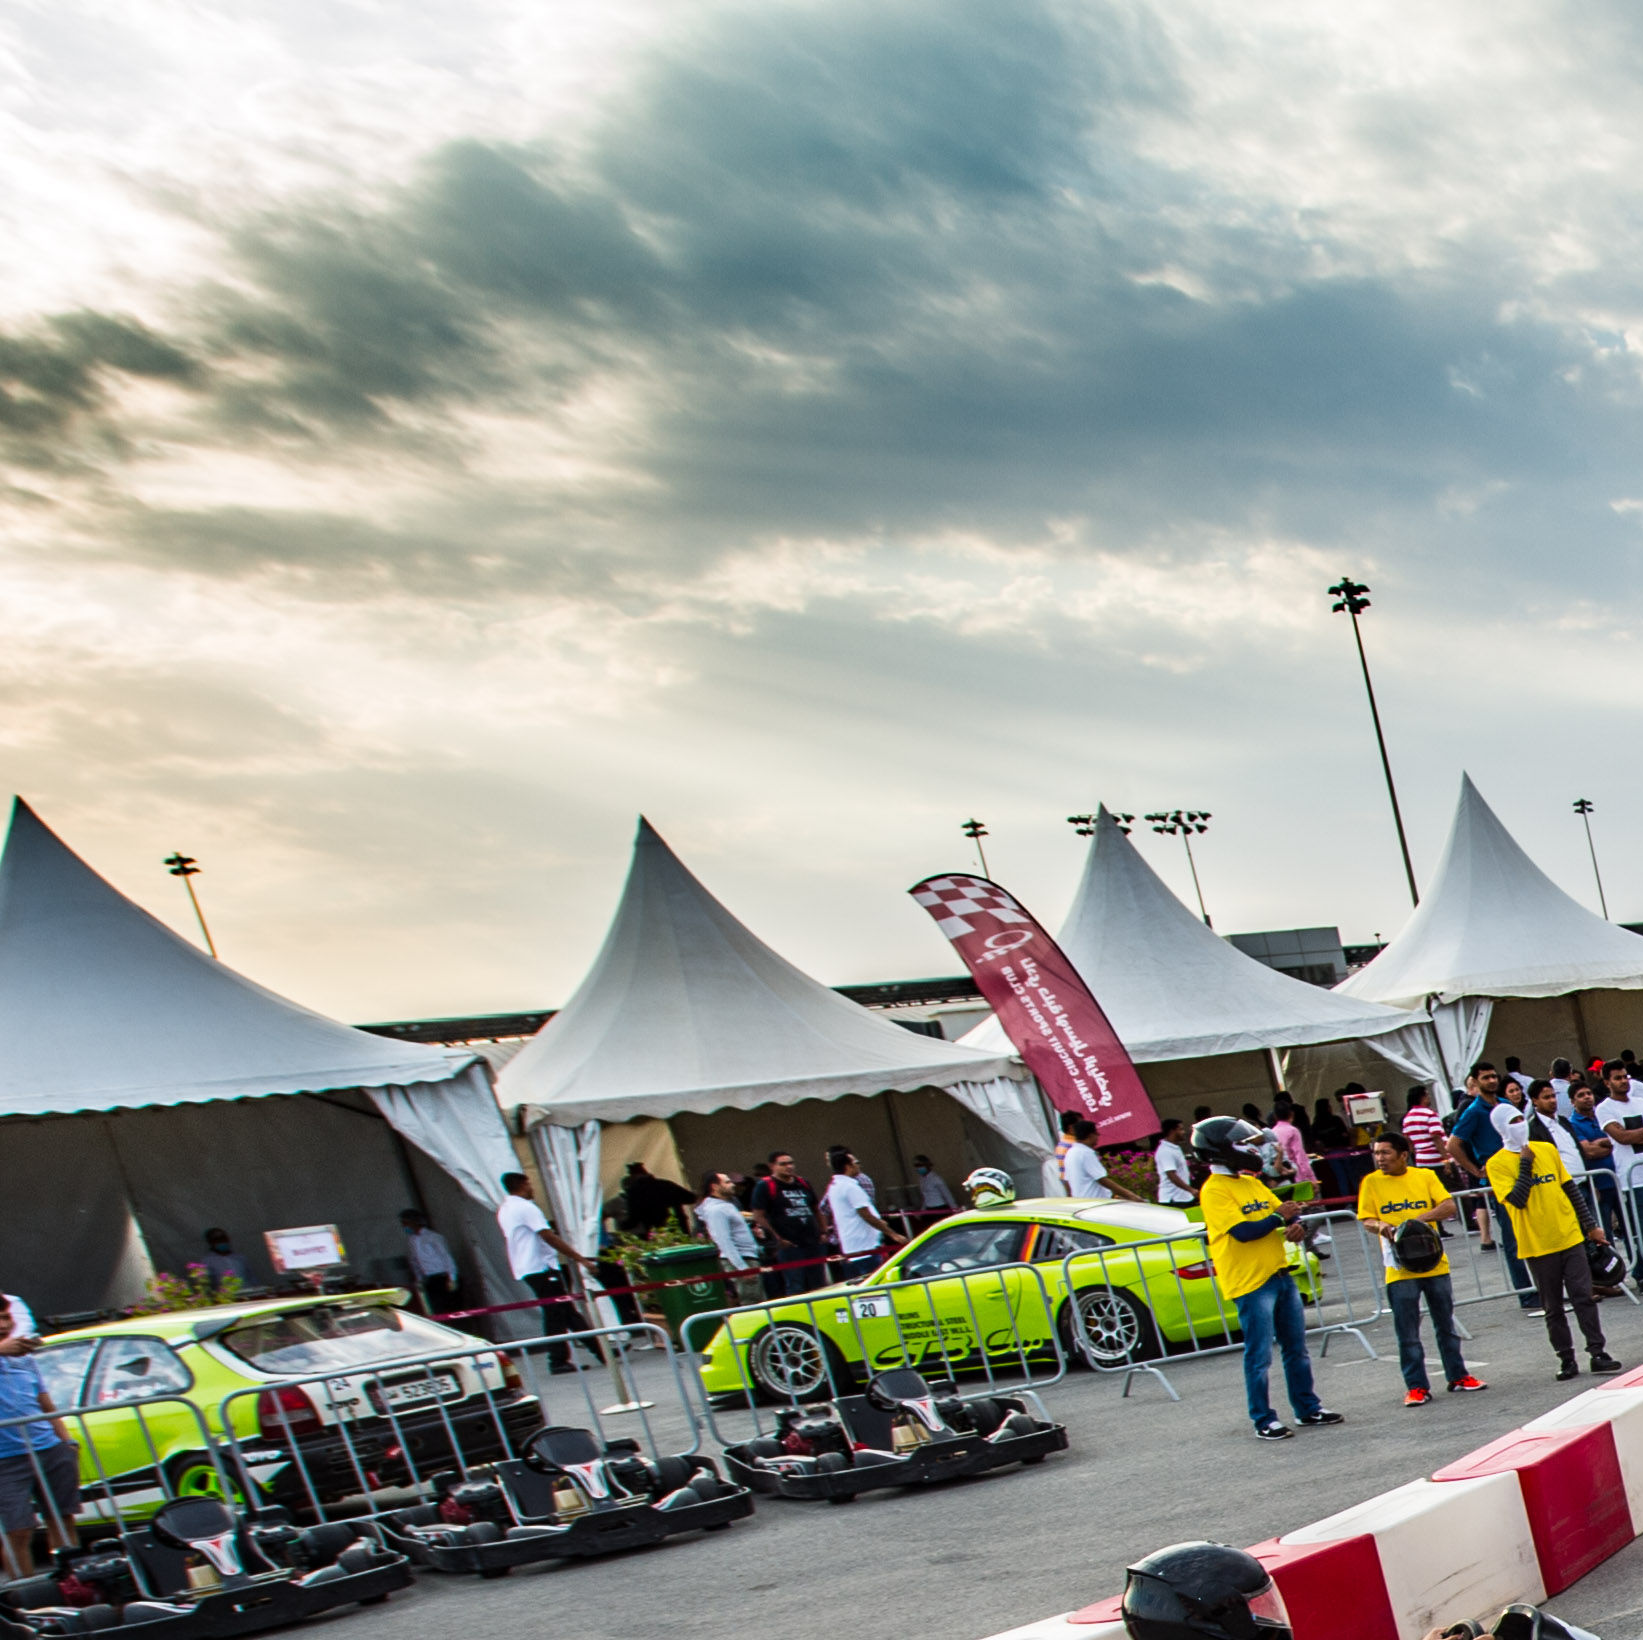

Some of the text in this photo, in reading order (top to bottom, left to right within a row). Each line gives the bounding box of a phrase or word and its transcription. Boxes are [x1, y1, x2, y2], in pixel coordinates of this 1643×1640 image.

[1381, 1199, 1428, 1214] doka
[859, 1303, 877, 1318] 20
[331, 1378, 350, 1391] 24
